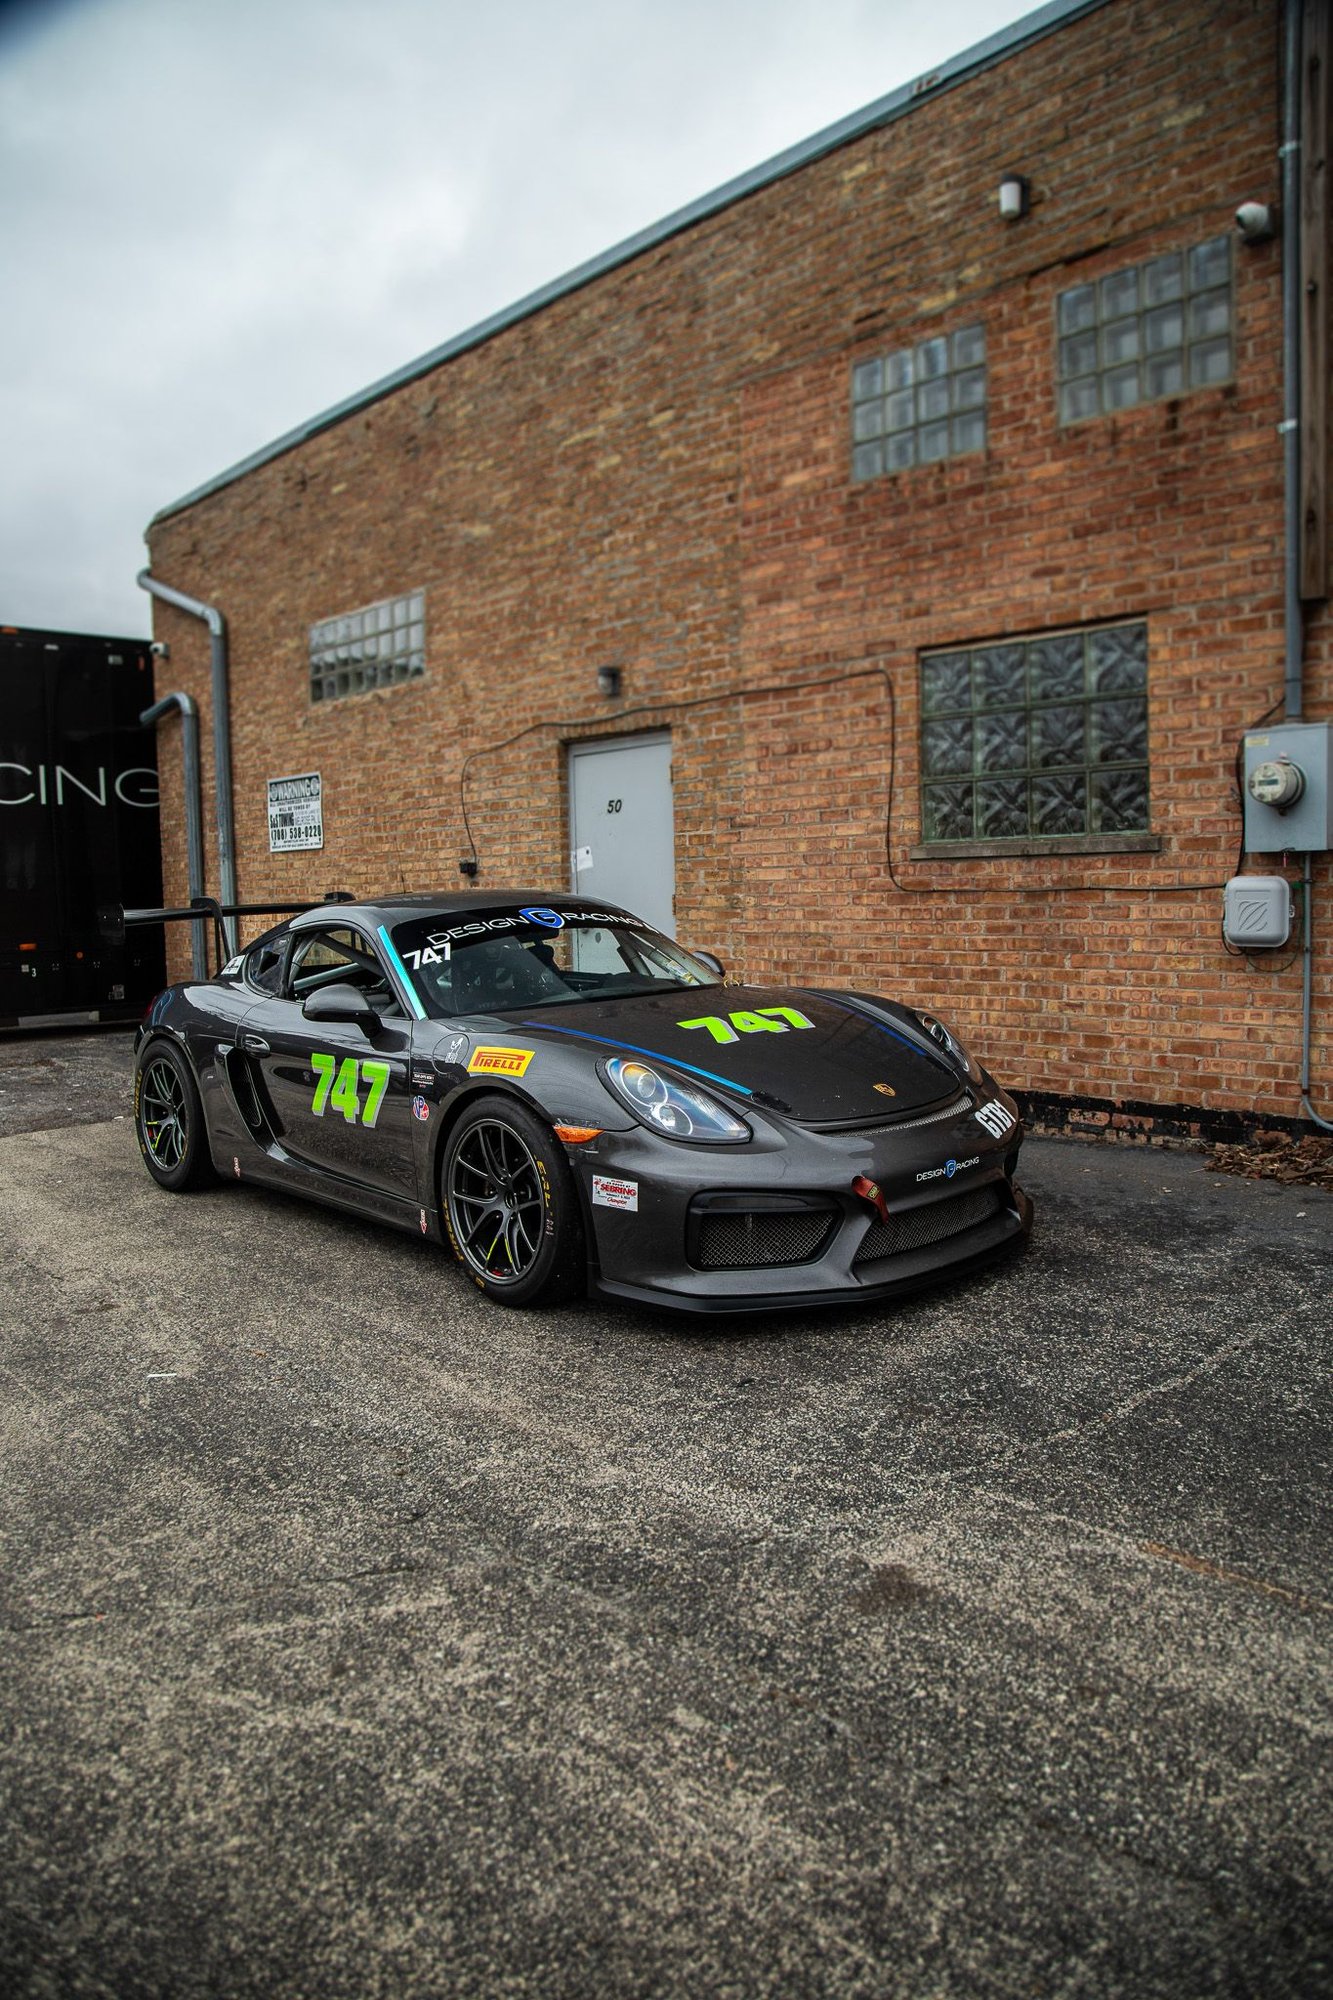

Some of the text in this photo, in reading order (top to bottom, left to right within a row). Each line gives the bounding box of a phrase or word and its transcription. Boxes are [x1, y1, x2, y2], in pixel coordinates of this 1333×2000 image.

[277, 779, 311, 800] WARNING
[607, 799, 622, 814] 50
[279, 812, 294, 827] TOWING
[271, 825, 321, 841] (708) 538-0220
[426, 912, 644, 947] DESIGN RACING
[402, 942, 451, 971] 747
[31, 967, 37, 978] 3
[677, 1006, 816, 1045] 747
[473, 1051, 526, 1071] PIRELLI
[311, 1053, 390, 1128] 747
[974, 1098, 1017, 1140] GTB1
[916, 1156, 980, 1182] DESIGN RACING
[600, 1183, 637, 1196] SEBRING
